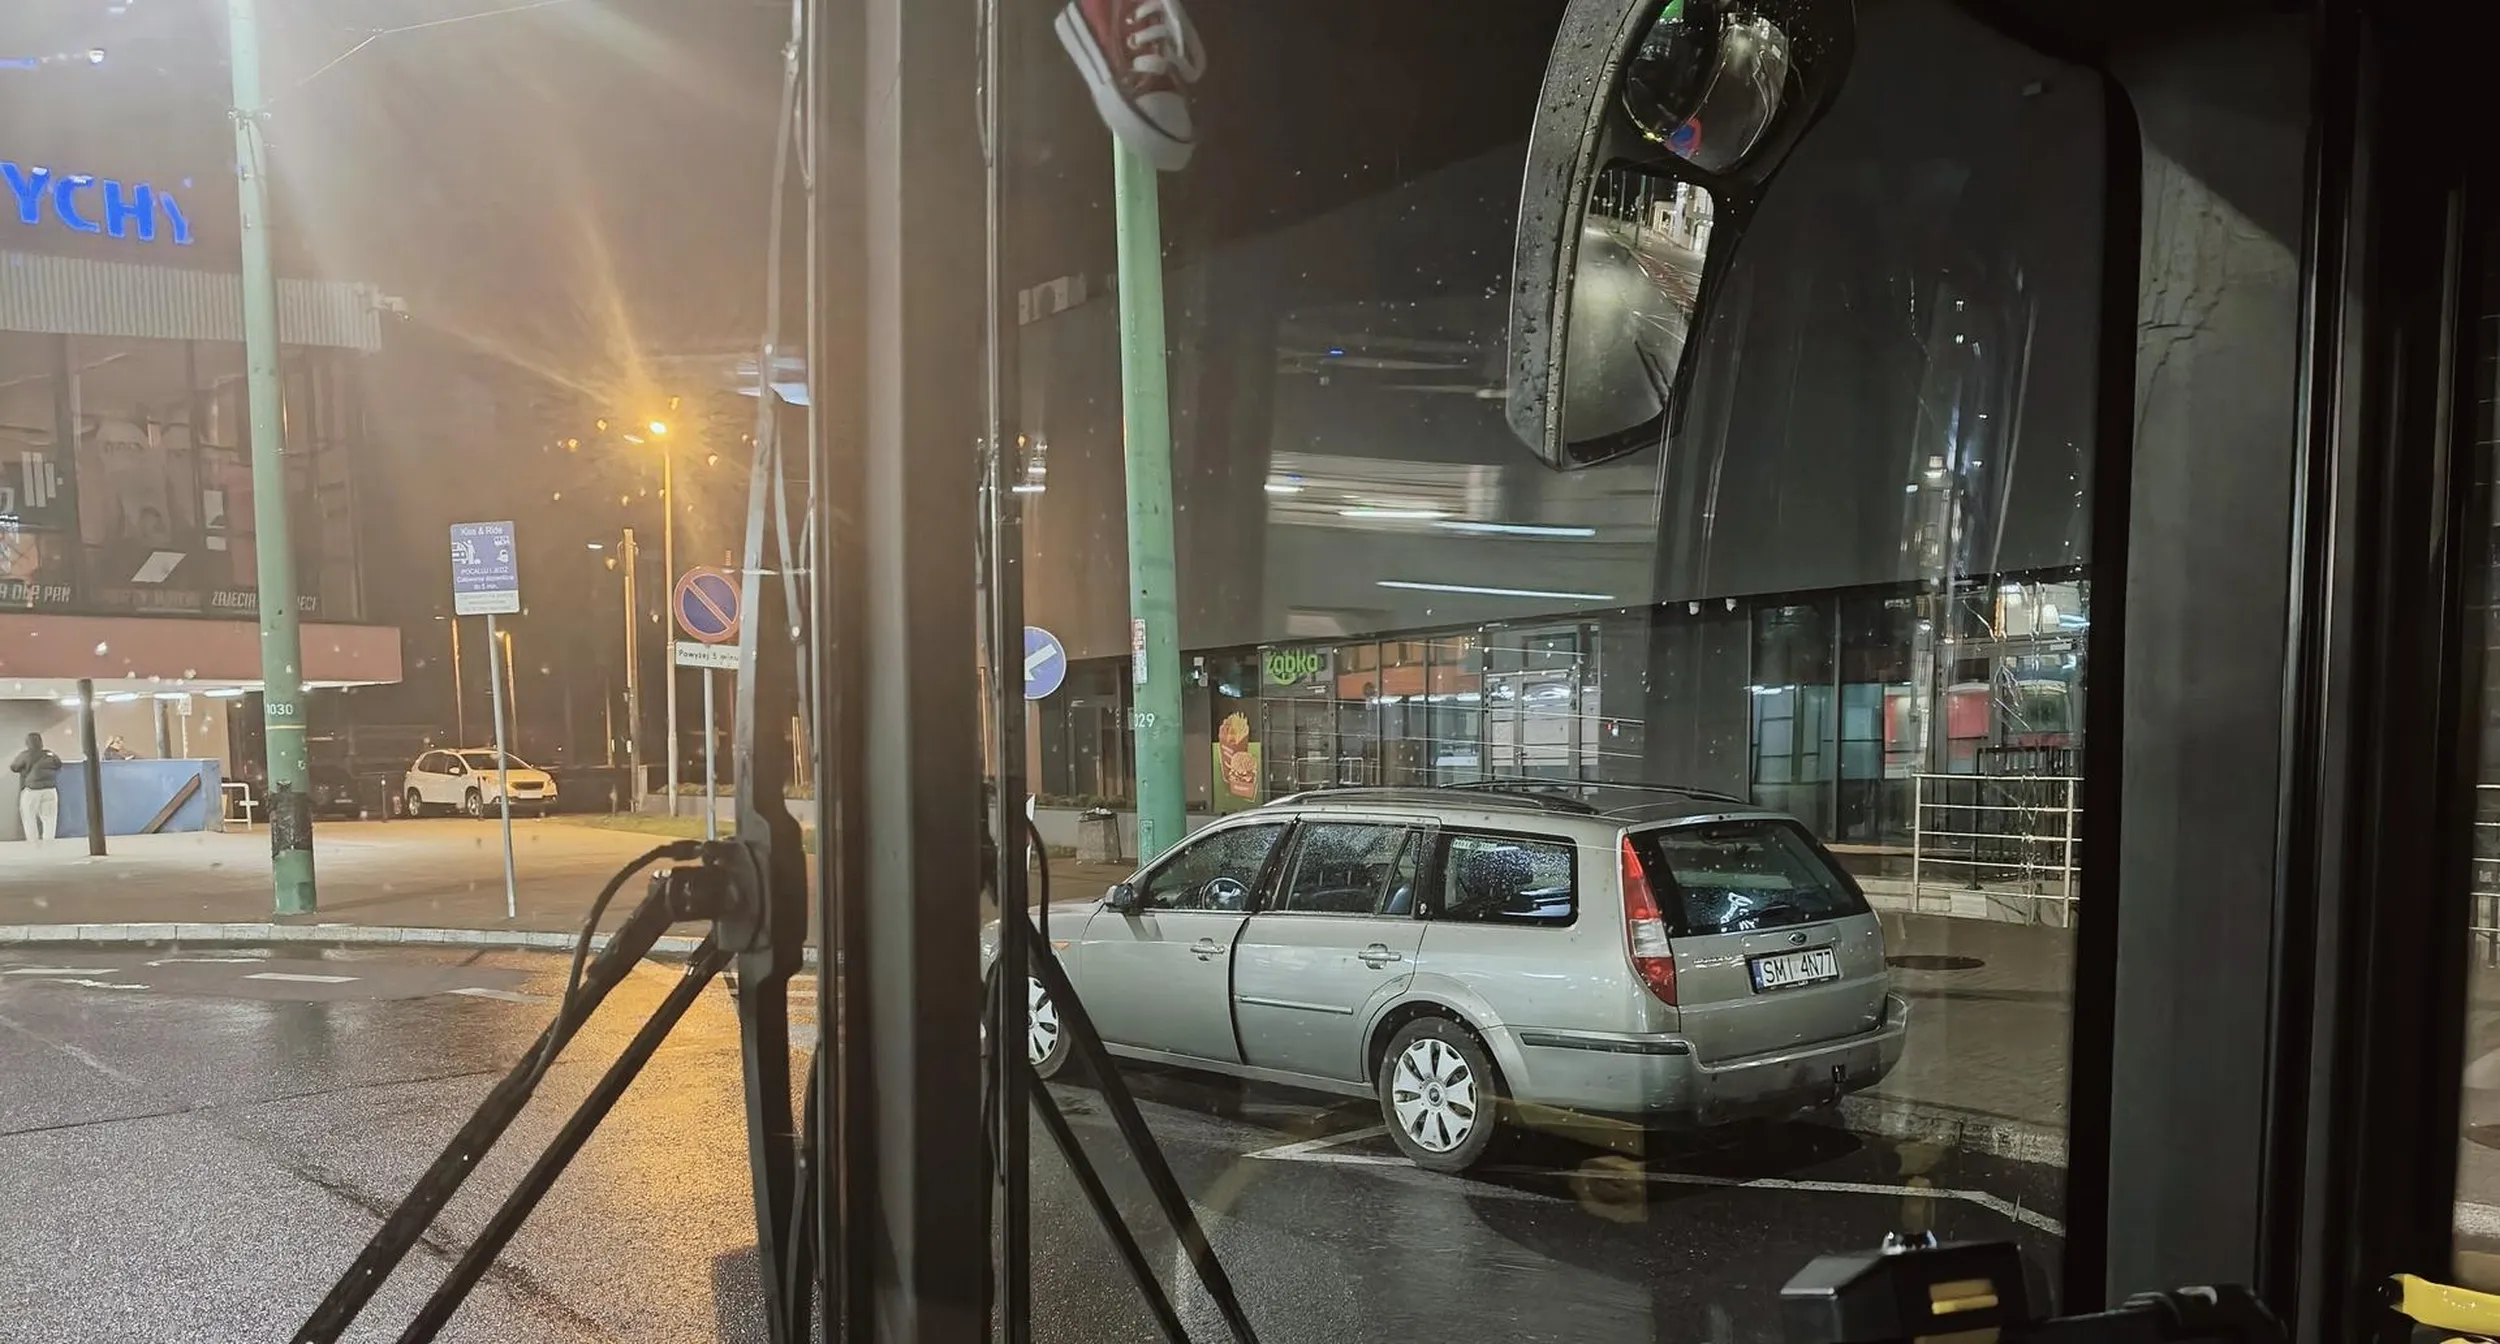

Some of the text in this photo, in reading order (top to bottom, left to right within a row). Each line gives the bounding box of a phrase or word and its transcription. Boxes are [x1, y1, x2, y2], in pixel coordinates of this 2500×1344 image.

[266, 703, 293, 715] 1030
[1763, 957, 1794, 983] SMI
[1801, 951, 1832, 977] 4N77
